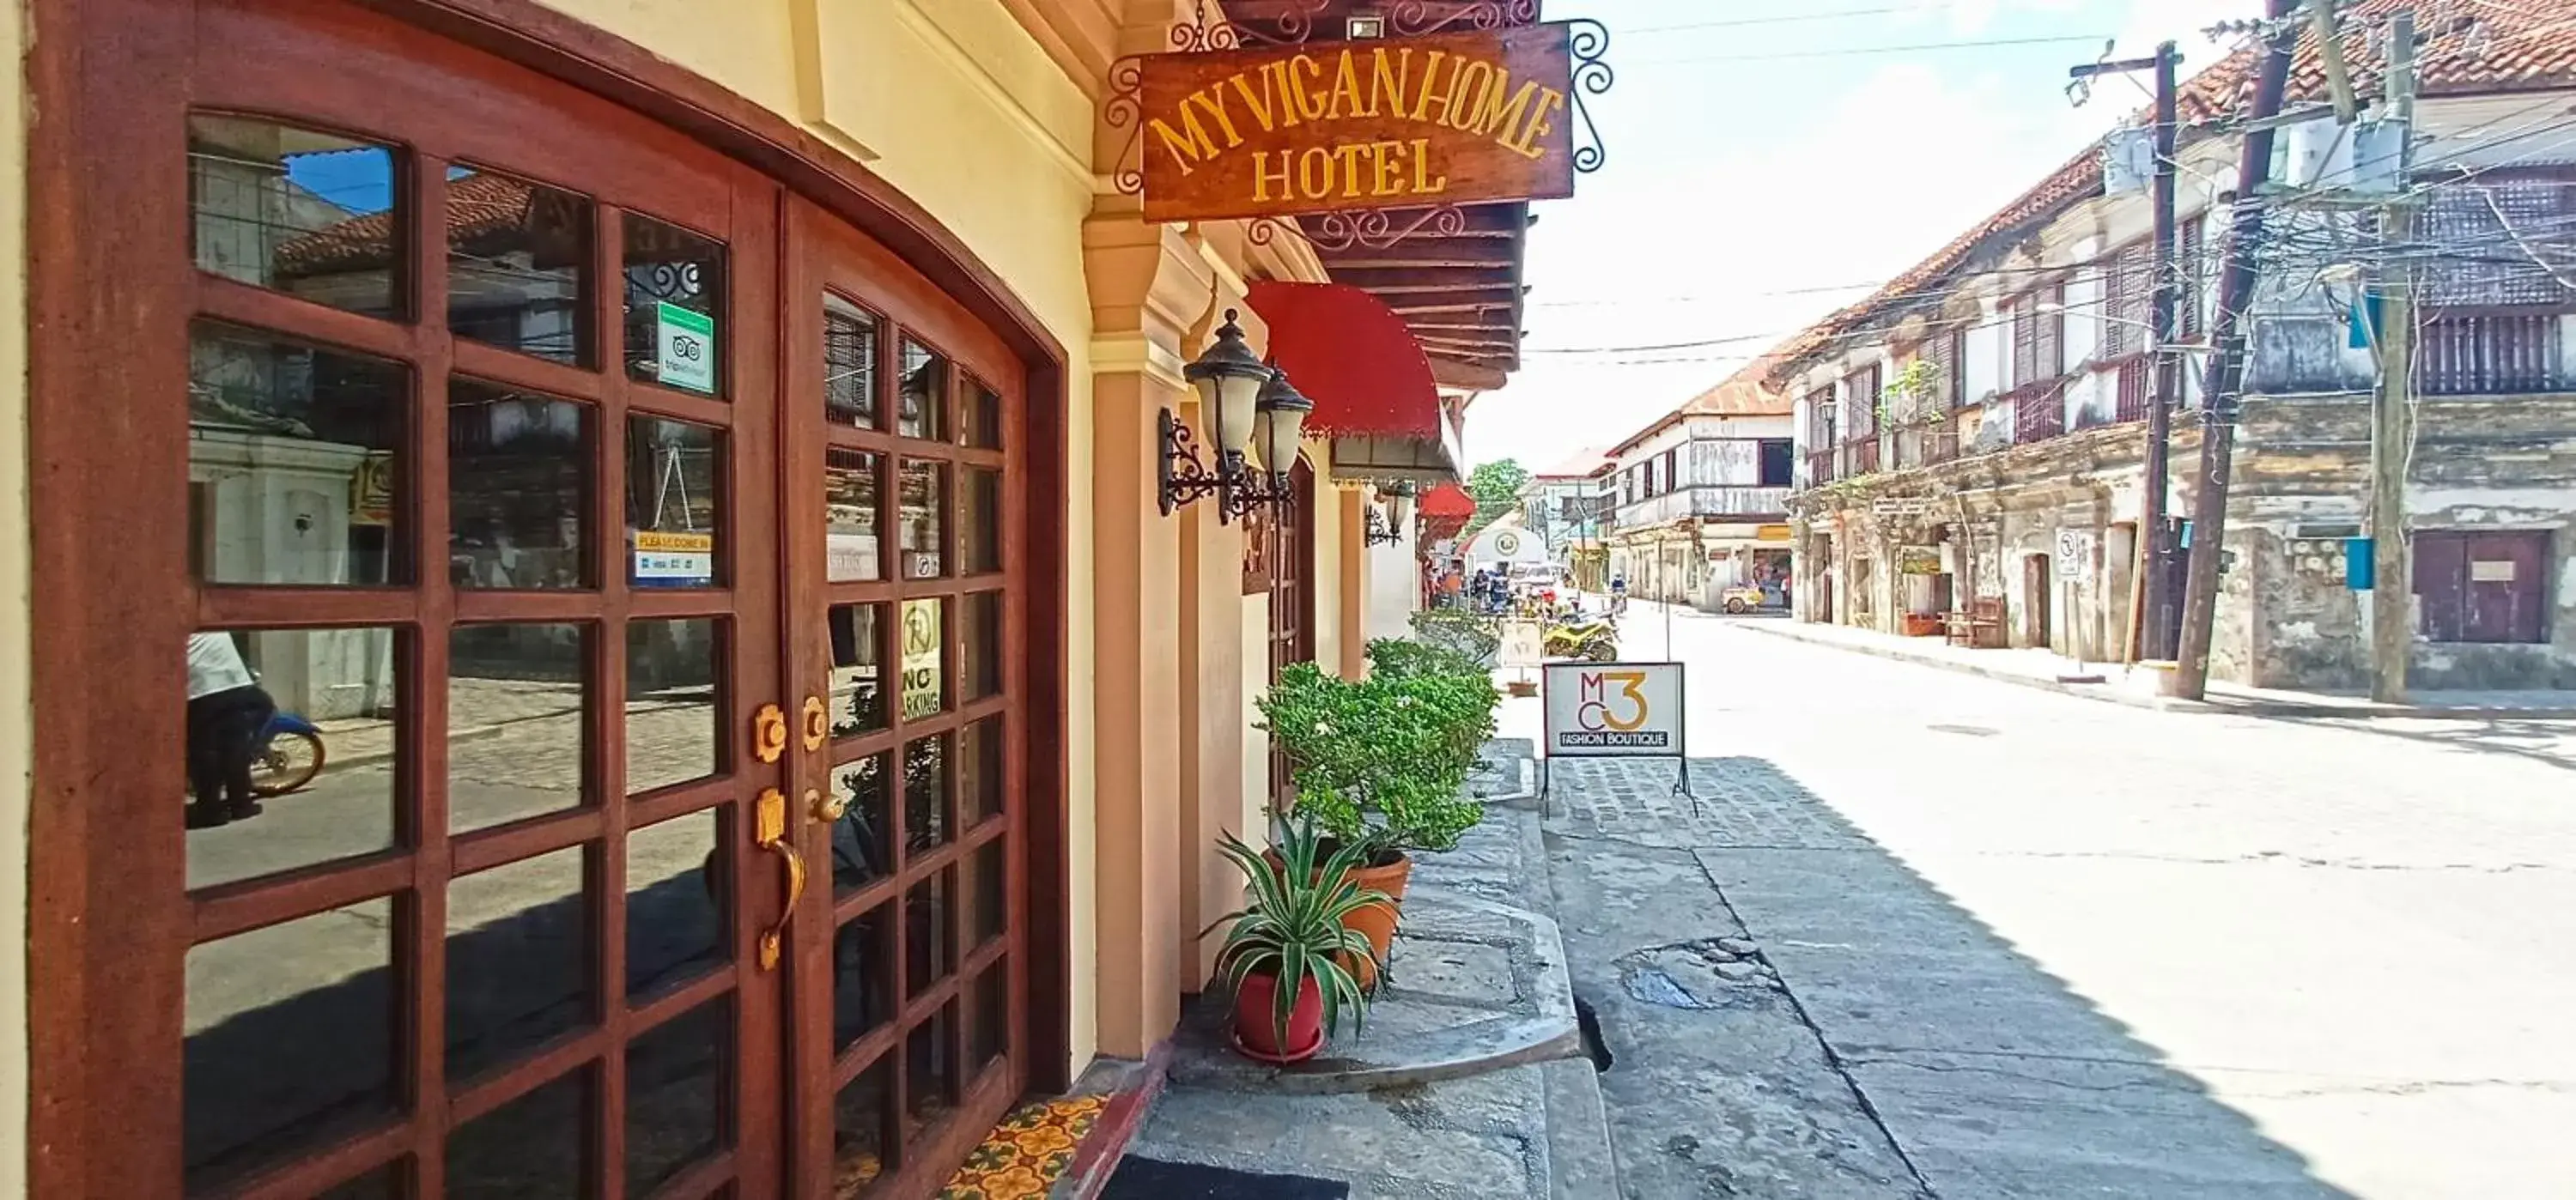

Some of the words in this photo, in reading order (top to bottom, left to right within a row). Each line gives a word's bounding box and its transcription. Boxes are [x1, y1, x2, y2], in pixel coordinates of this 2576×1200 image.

[1150, 82, 1244, 177] MY
[1230, 47, 1413, 132] VIGAN
[1411, 51, 1564, 160] HOME
[1251, 138, 1447, 203] HOTEL
[1562, 733, 1604, 745] FASHION
[1607, 732, 1666, 745] BOUTIQUE
